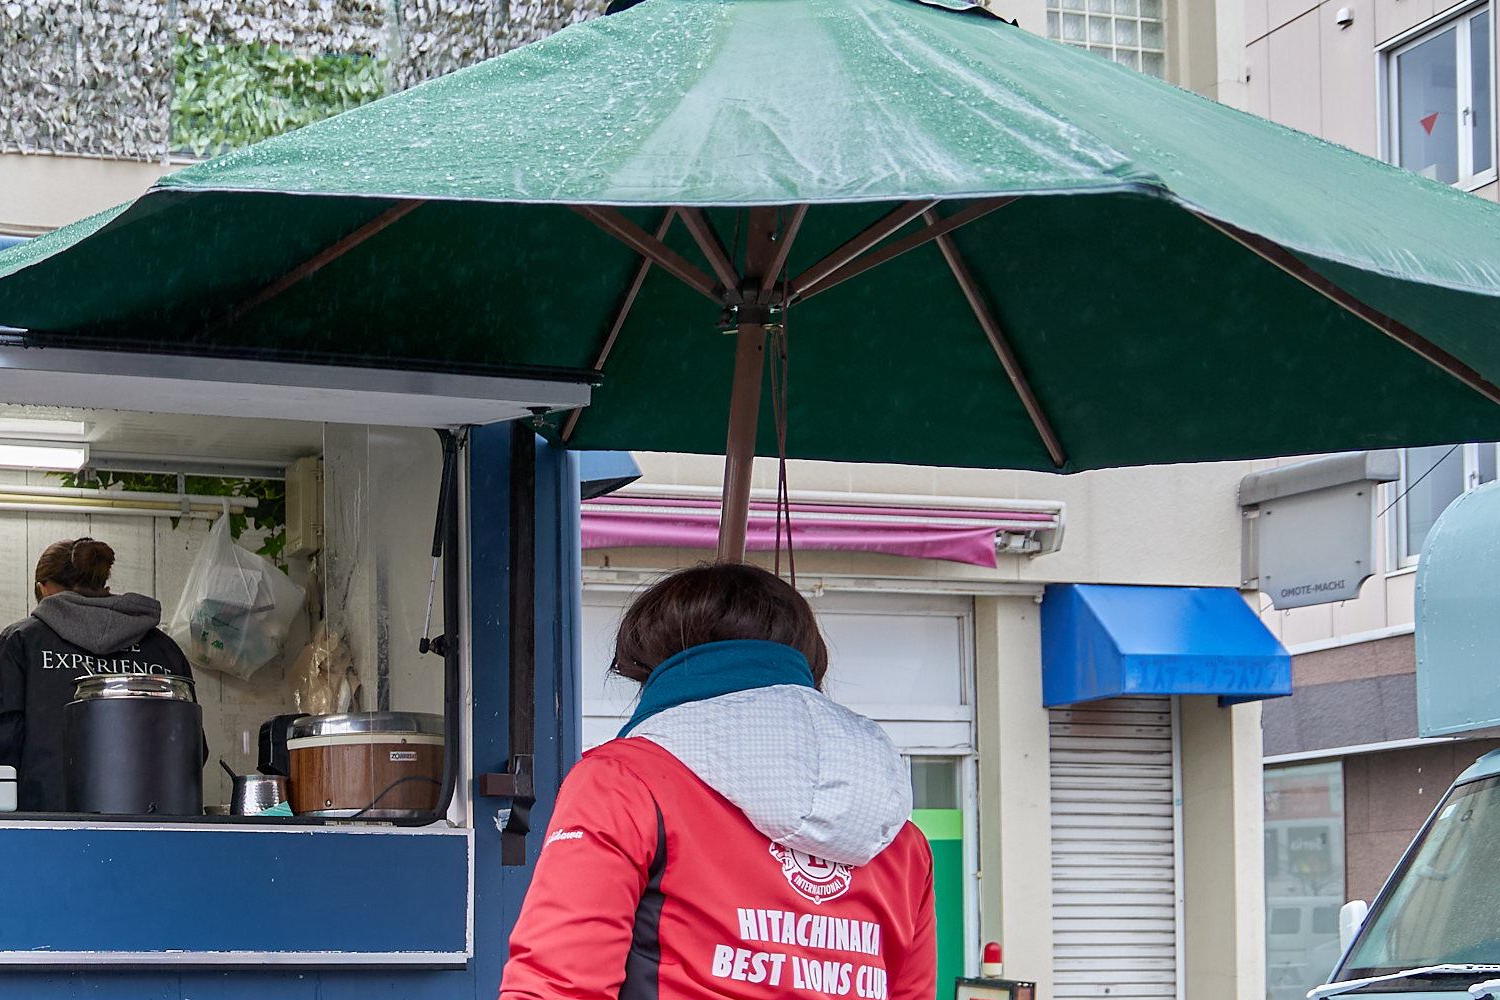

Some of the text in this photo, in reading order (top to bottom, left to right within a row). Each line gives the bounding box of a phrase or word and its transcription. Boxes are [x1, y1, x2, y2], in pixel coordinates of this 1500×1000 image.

[1281, 579, 1346, 598] OMOTE-MACHI
[794, 874, 844, 896] INTERNATIONAL
[737, 908, 881, 956] HITACHINAKA
[712, 944, 888, 1000] BEST LIONS CLUB
